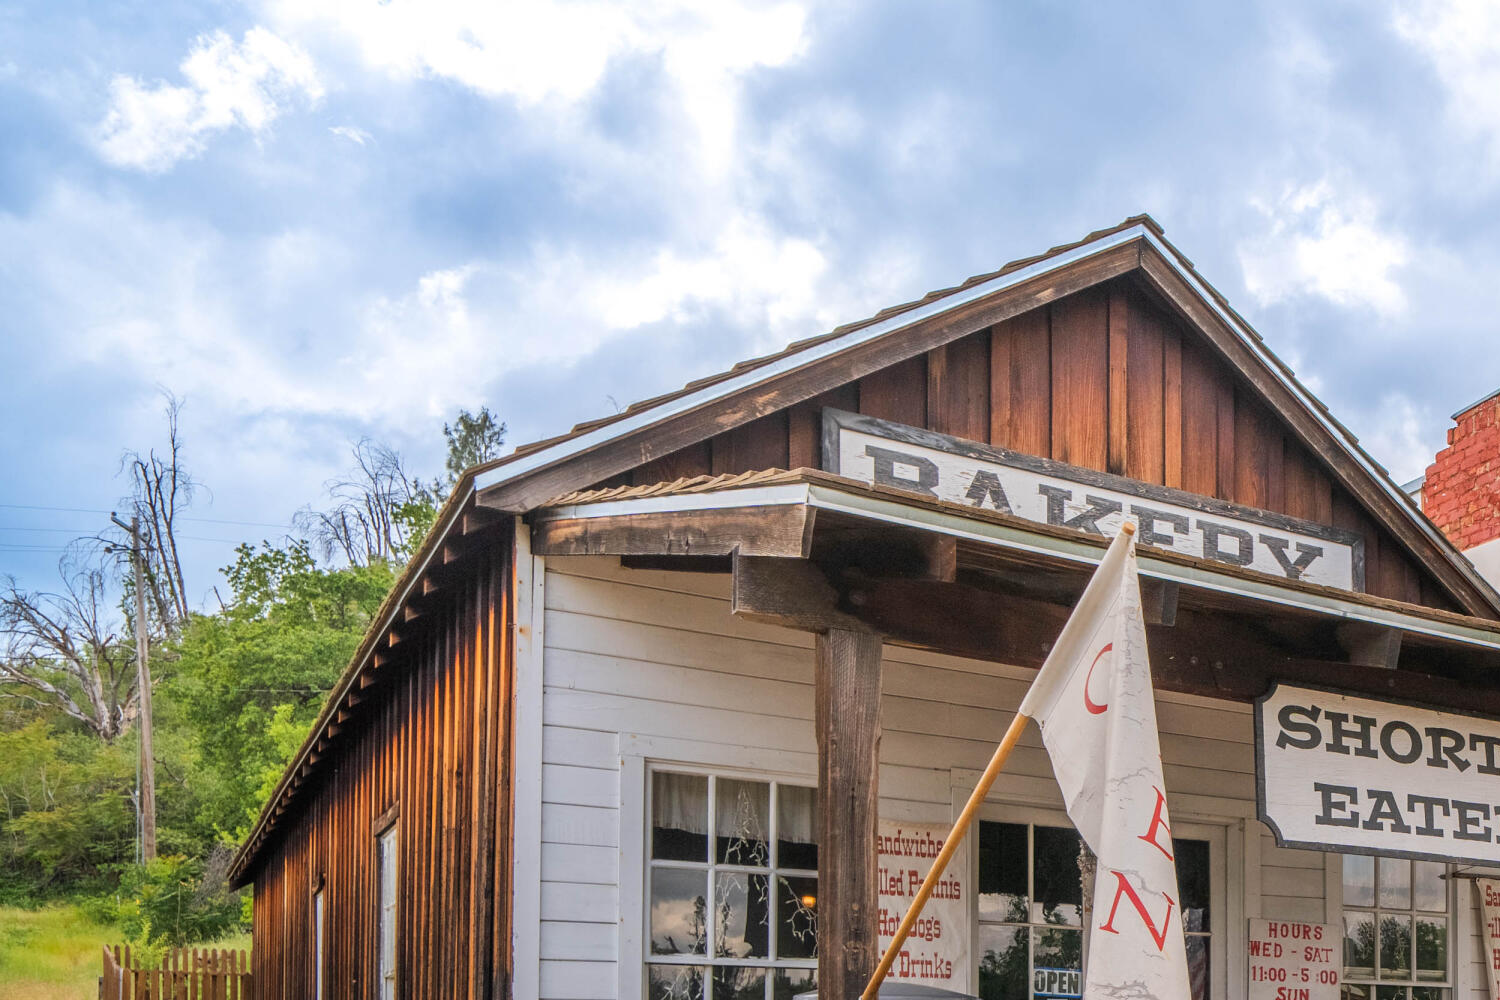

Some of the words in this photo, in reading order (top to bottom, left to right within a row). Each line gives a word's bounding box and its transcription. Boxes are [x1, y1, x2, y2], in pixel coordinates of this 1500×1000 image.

[878, 829, 946, 858] andwiche
[1268, 922, 1323, 940] HOURS
[1250, 940, 1283, 958] WED
[1304, 946, 1333, 963] SAT
[899, 951, 951, 979] Drinks
[1034, 970, 1079, 994] OPEN
